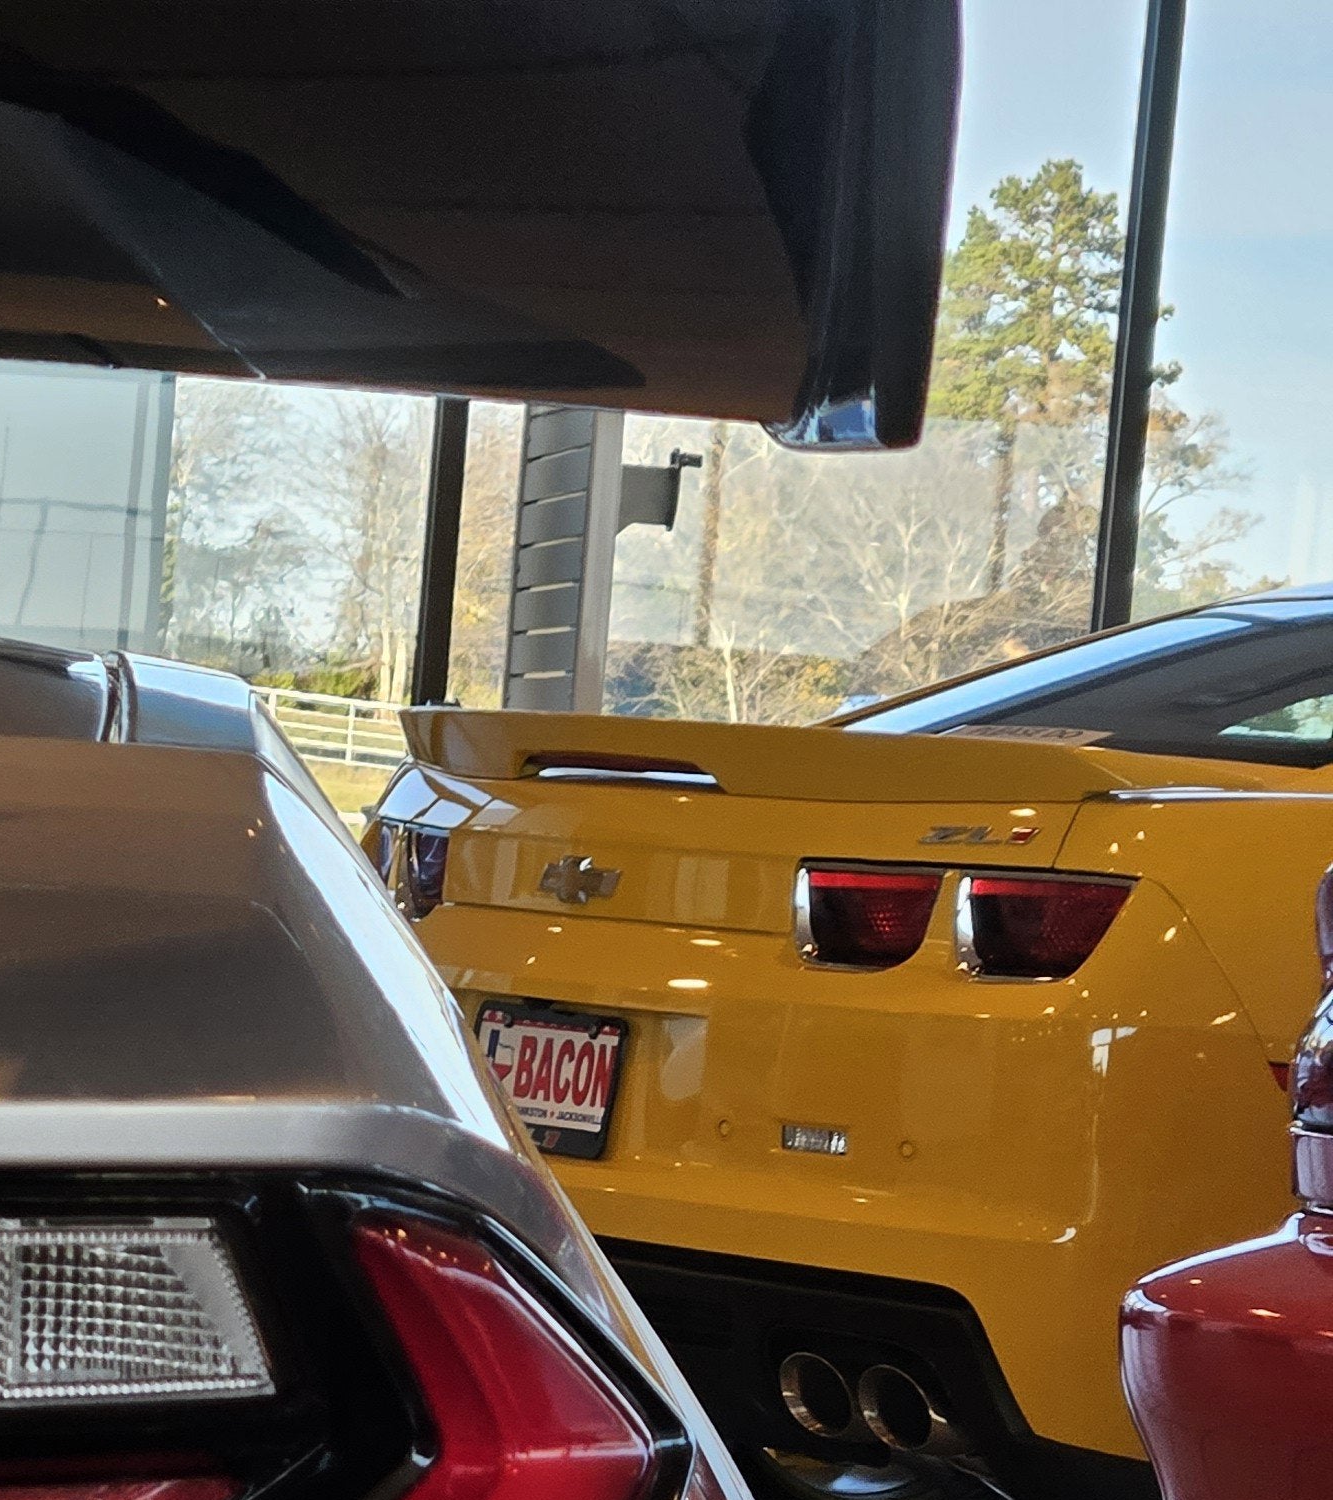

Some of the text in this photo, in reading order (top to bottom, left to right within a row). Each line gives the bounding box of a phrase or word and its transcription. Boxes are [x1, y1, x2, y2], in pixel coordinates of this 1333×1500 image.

[918, 825, 1041, 845] ZL1
[514, 1036, 617, 1108] BACON
[556, 1111, 601, 1125] JACKSONVILL
